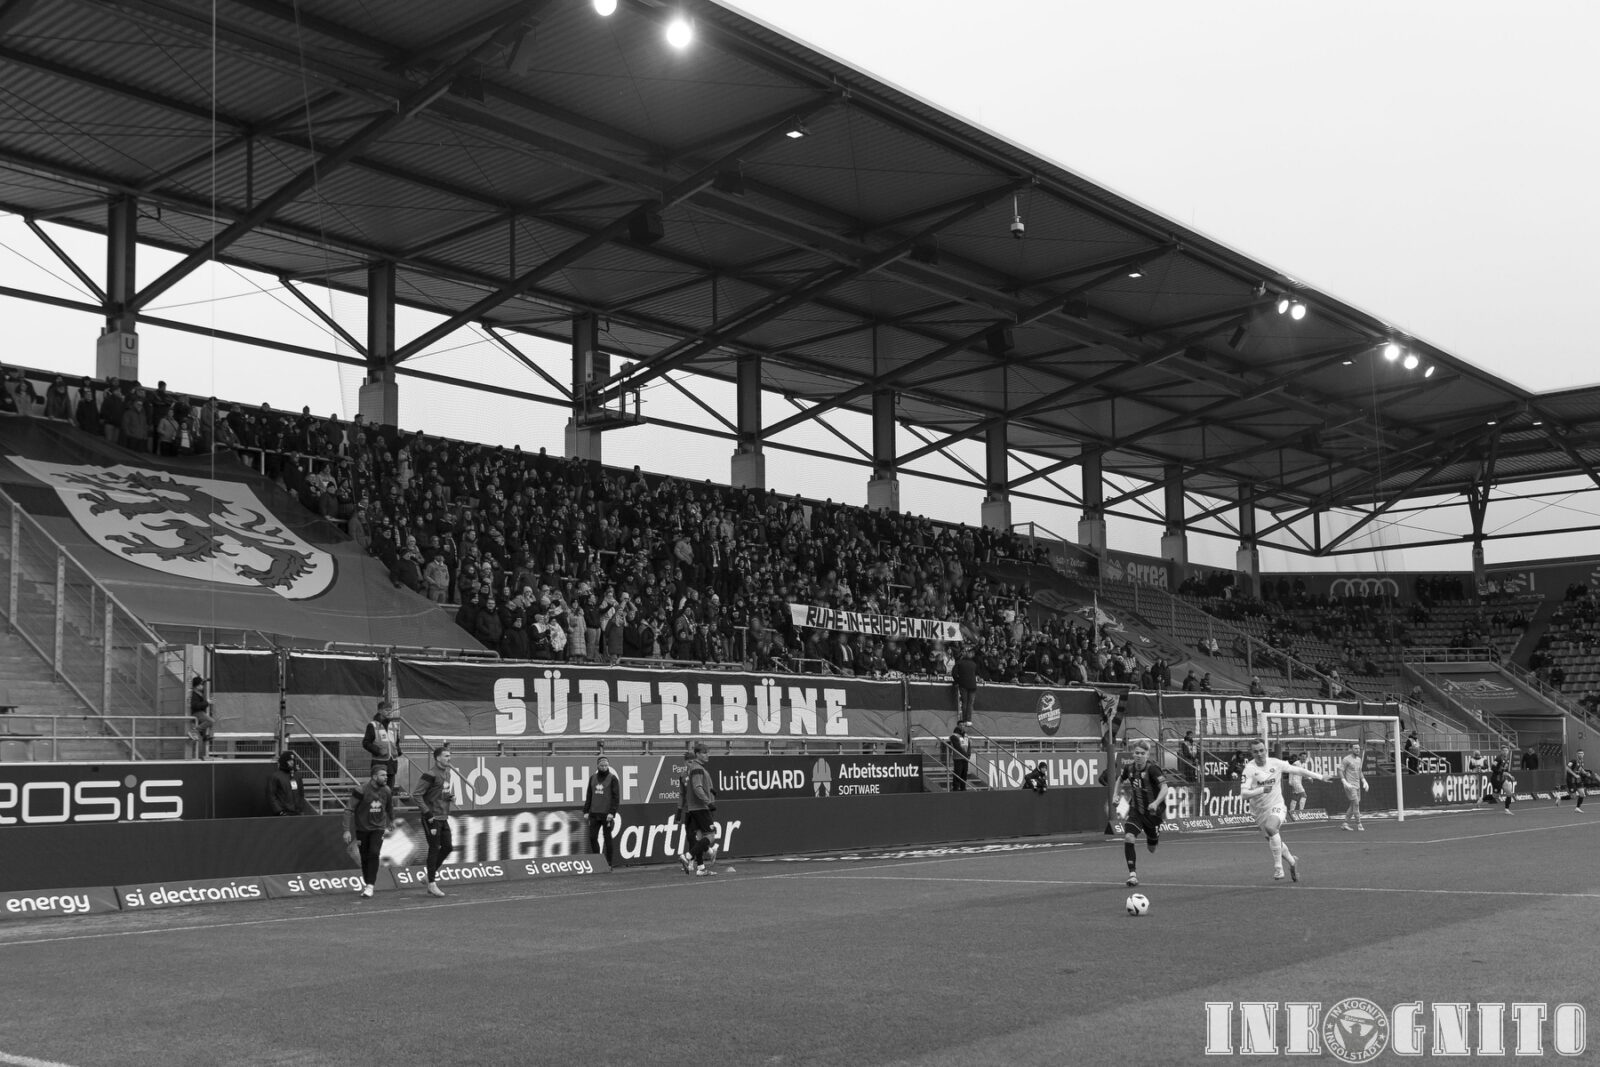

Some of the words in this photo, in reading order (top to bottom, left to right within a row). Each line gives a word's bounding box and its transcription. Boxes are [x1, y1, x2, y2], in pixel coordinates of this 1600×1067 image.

[494, 670, 848, 735] SÜDTRIBÜNE
[839, 763, 919, 779] Arbeitsschutz
[1204, 761, 1229, 776] STAFF
[450, 757, 639, 805] ÖBELHF
[719, 770, 805, 791] luitGUARD
[1446, 774, 1478, 802] errea
[839, 785, 880, 795] SOFTWARE
[397, 868, 414, 883] si
[525, 860, 539, 875] si
[542, 859, 594, 874] energy
[288, 875, 305, 892] si
[125, 888, 146, 906] si
[149, 882, 261, 905] electronics
[6, 894, 91, 913] energy
